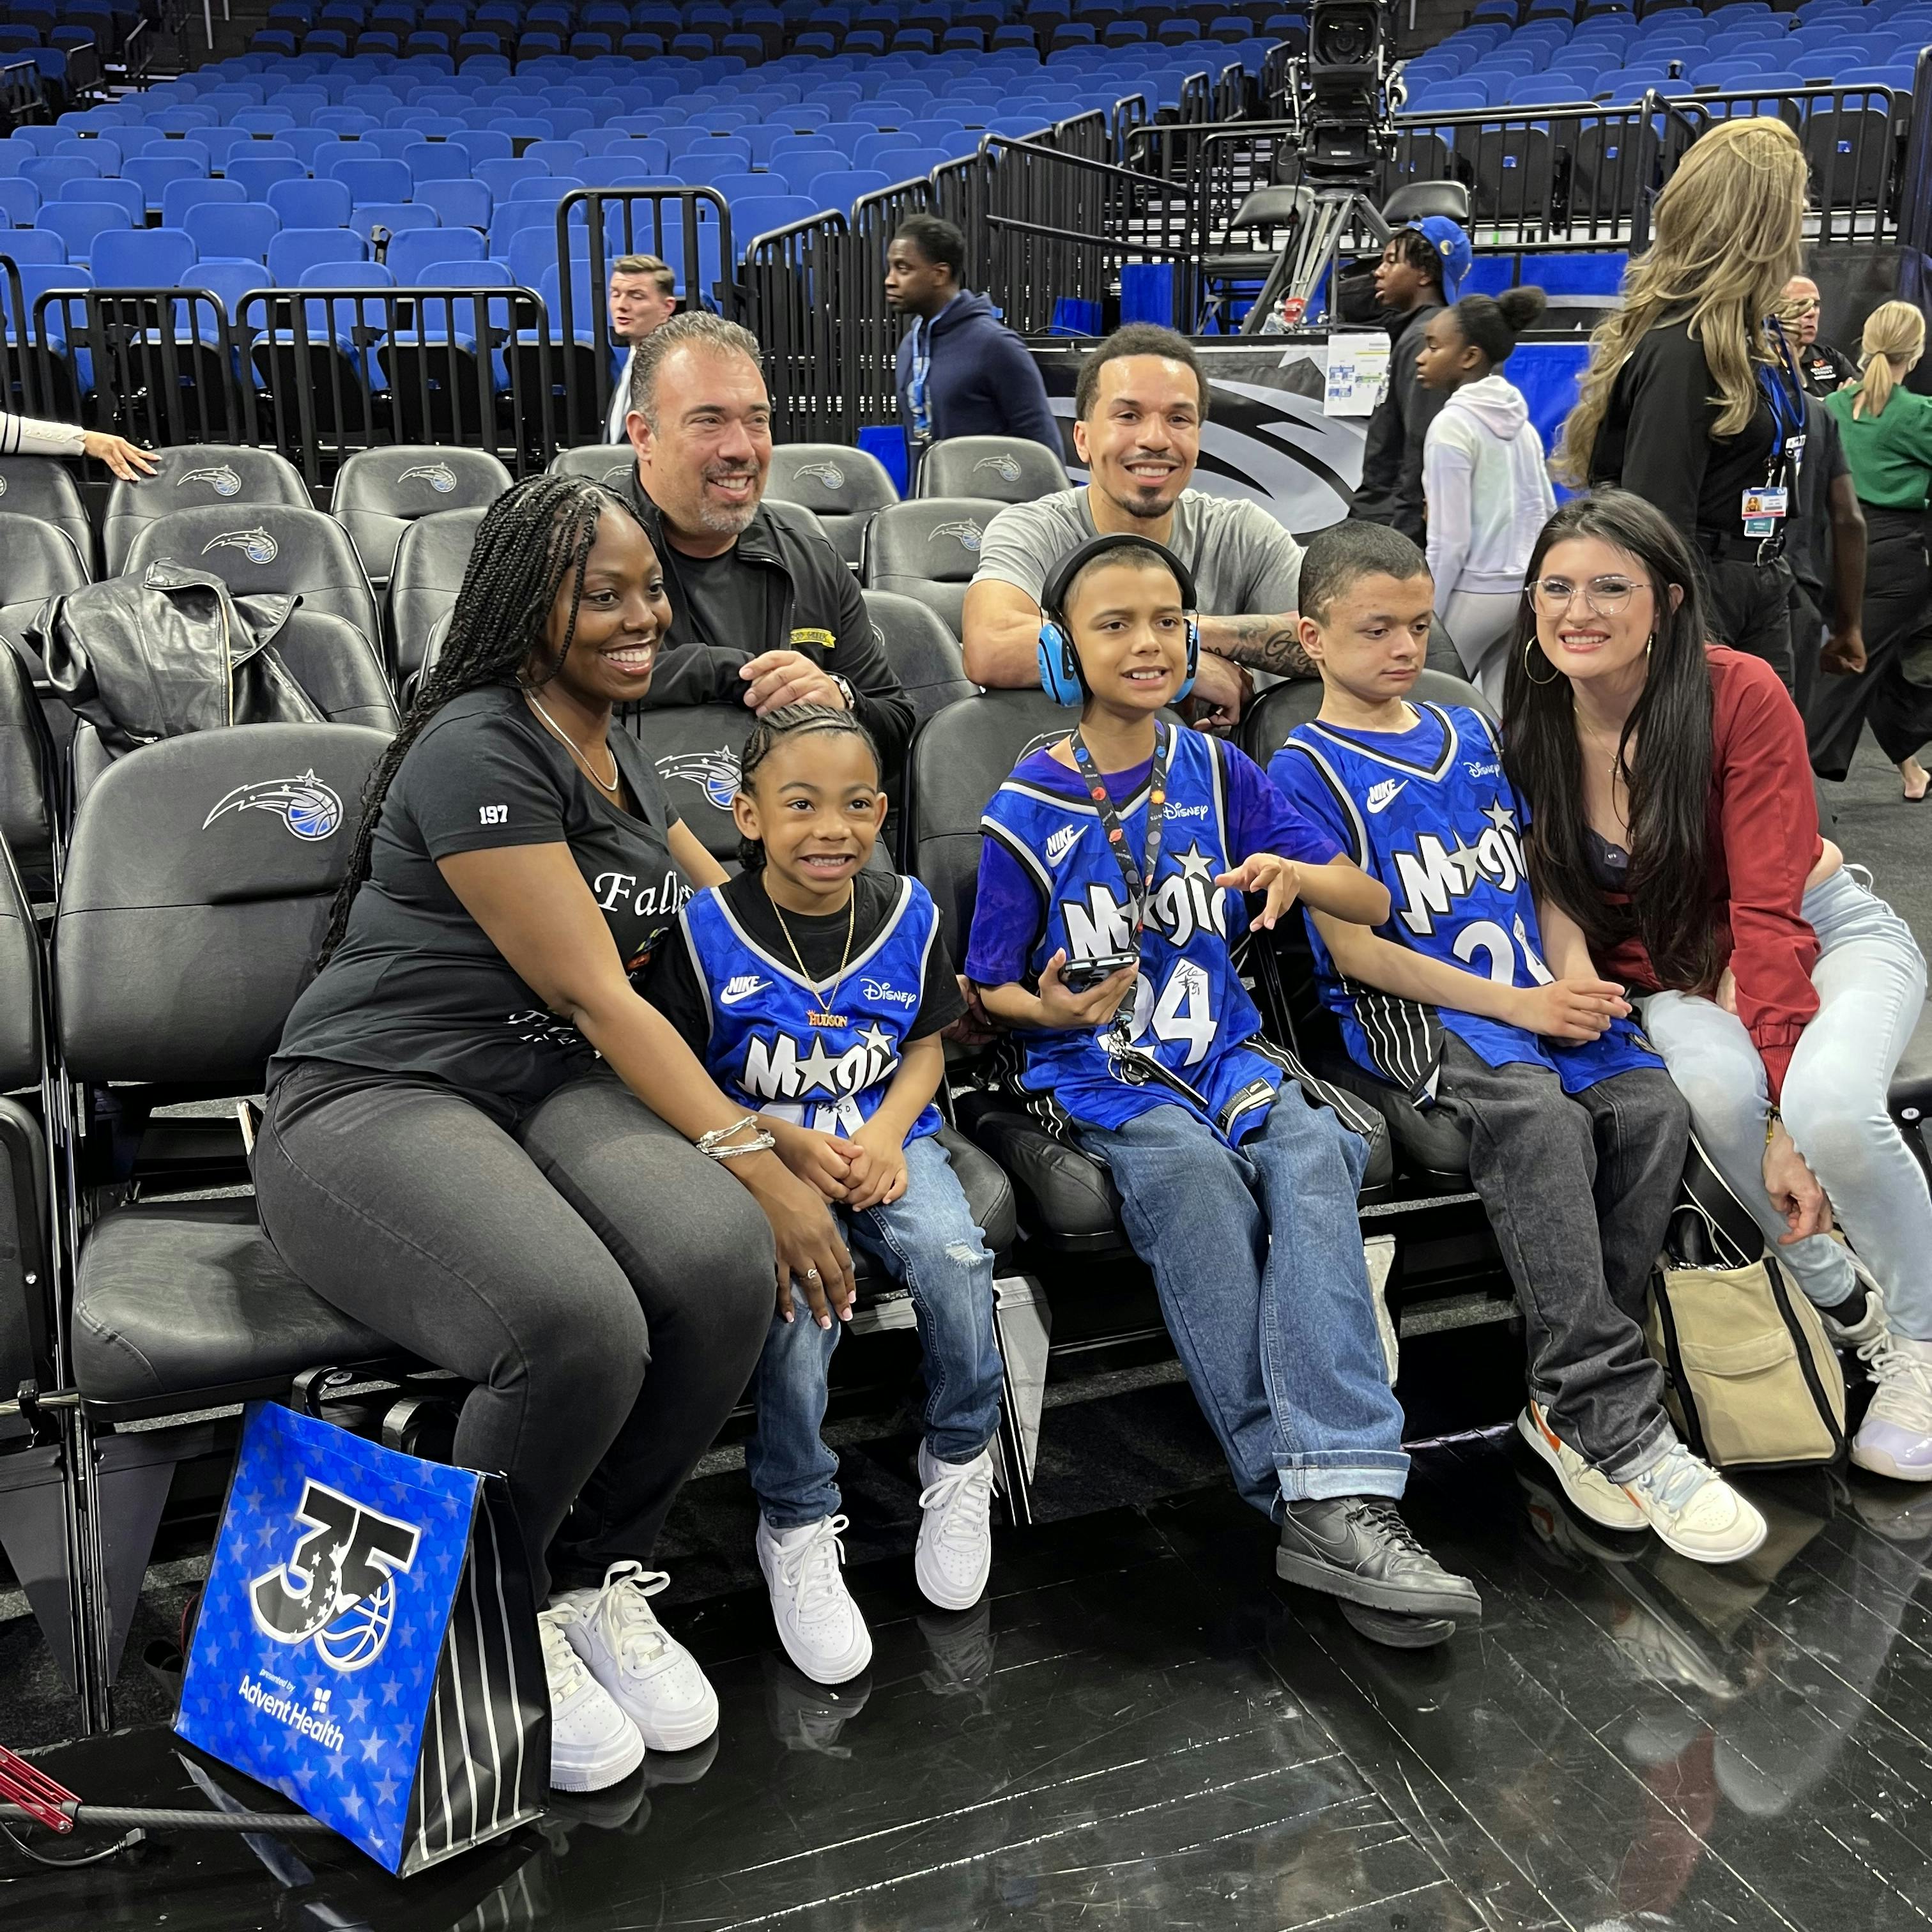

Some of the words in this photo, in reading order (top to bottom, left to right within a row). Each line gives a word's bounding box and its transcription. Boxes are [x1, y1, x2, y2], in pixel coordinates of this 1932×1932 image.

[1369, 779, 1396, 802] NIKE
[479, 804, 508, 824] 197
[1162, 802, 1209, 821] Disney
[1046, 824, 1074, 855] NIKE
[1394, 799, 1529, 935] Magi
[728, 976, 760, 993] NIKE
[860, 978, 917, 1010] Disney
[808, 1013, 848, 1027] HUDSON
[249, 1478, 423, 1672] 35
[259, 1668, 288, 1688] presented
[286, 1681, 296, 1692] by
